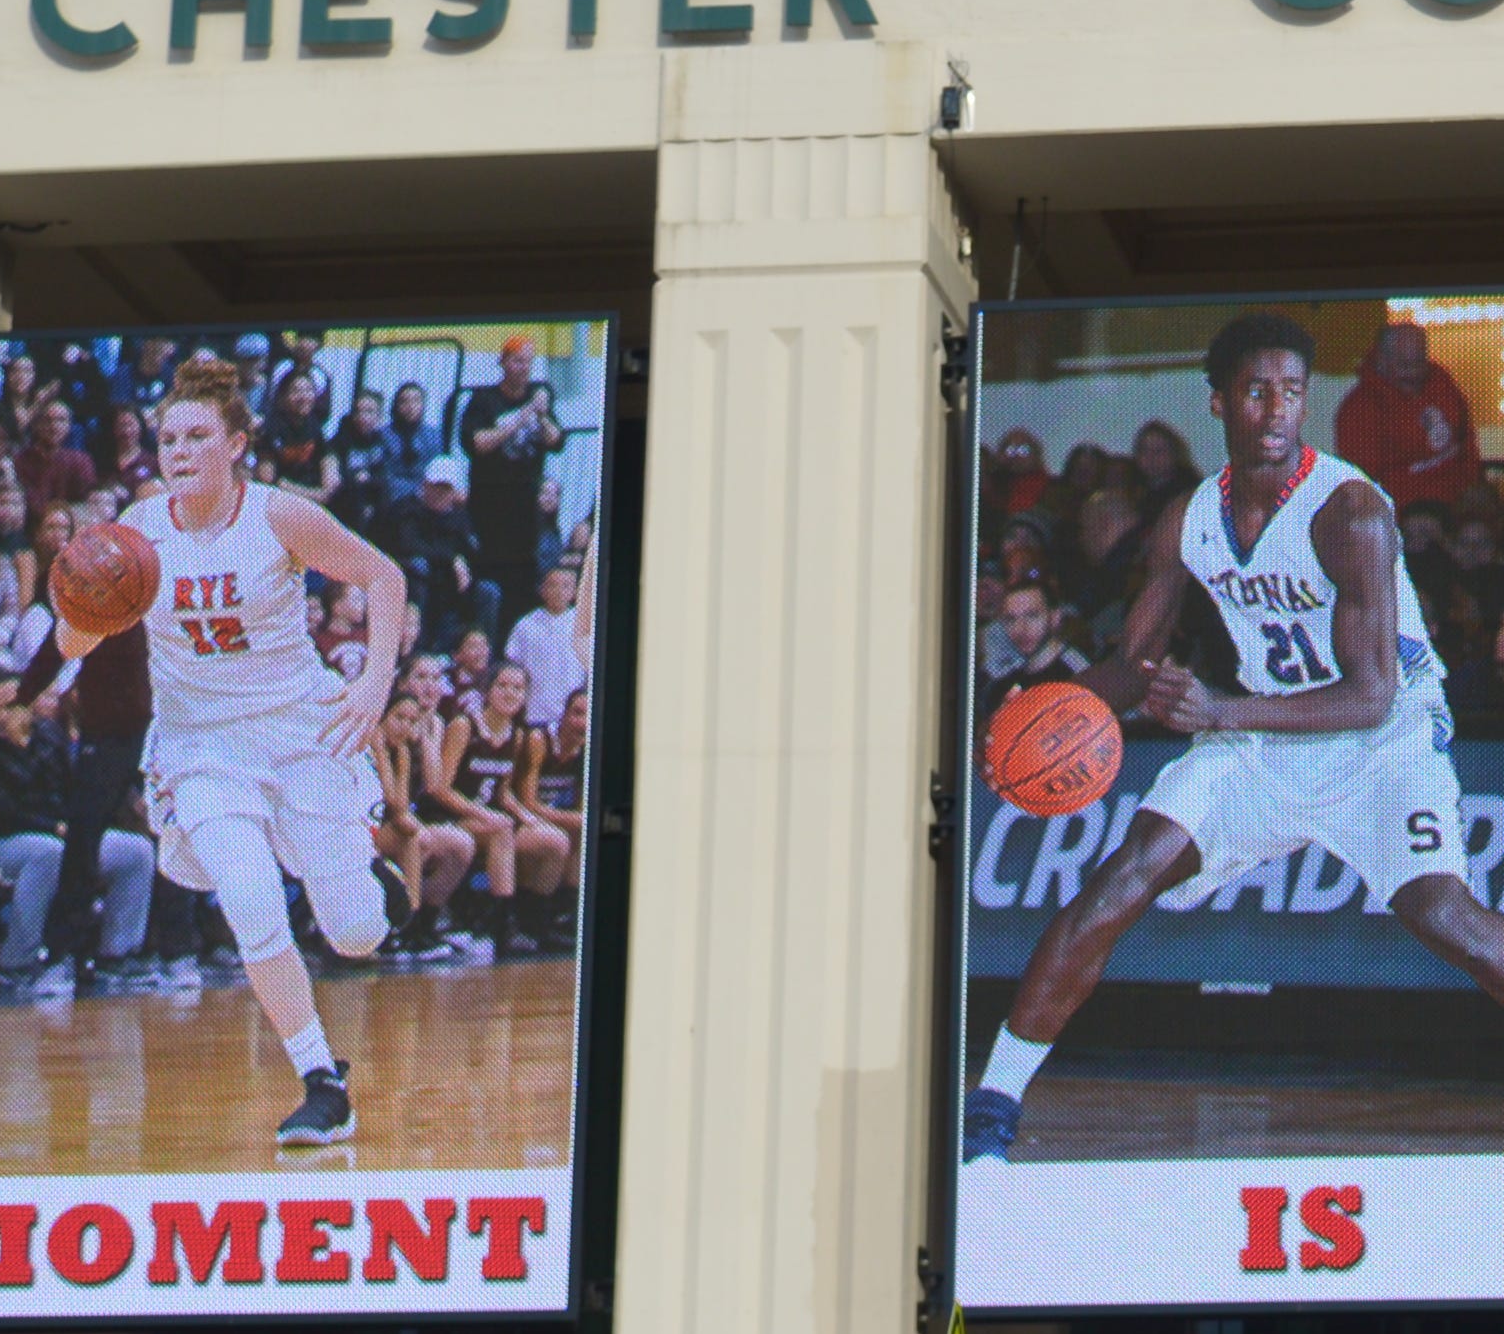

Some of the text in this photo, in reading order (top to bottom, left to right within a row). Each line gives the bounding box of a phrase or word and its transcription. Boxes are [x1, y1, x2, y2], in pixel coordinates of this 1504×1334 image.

[174, 572, 243, 610] RYE
[182, 617, 249, 656] 12
[1260, 621, 1333, 684] 21
[1240, 1185, 1367, 1272] IS
